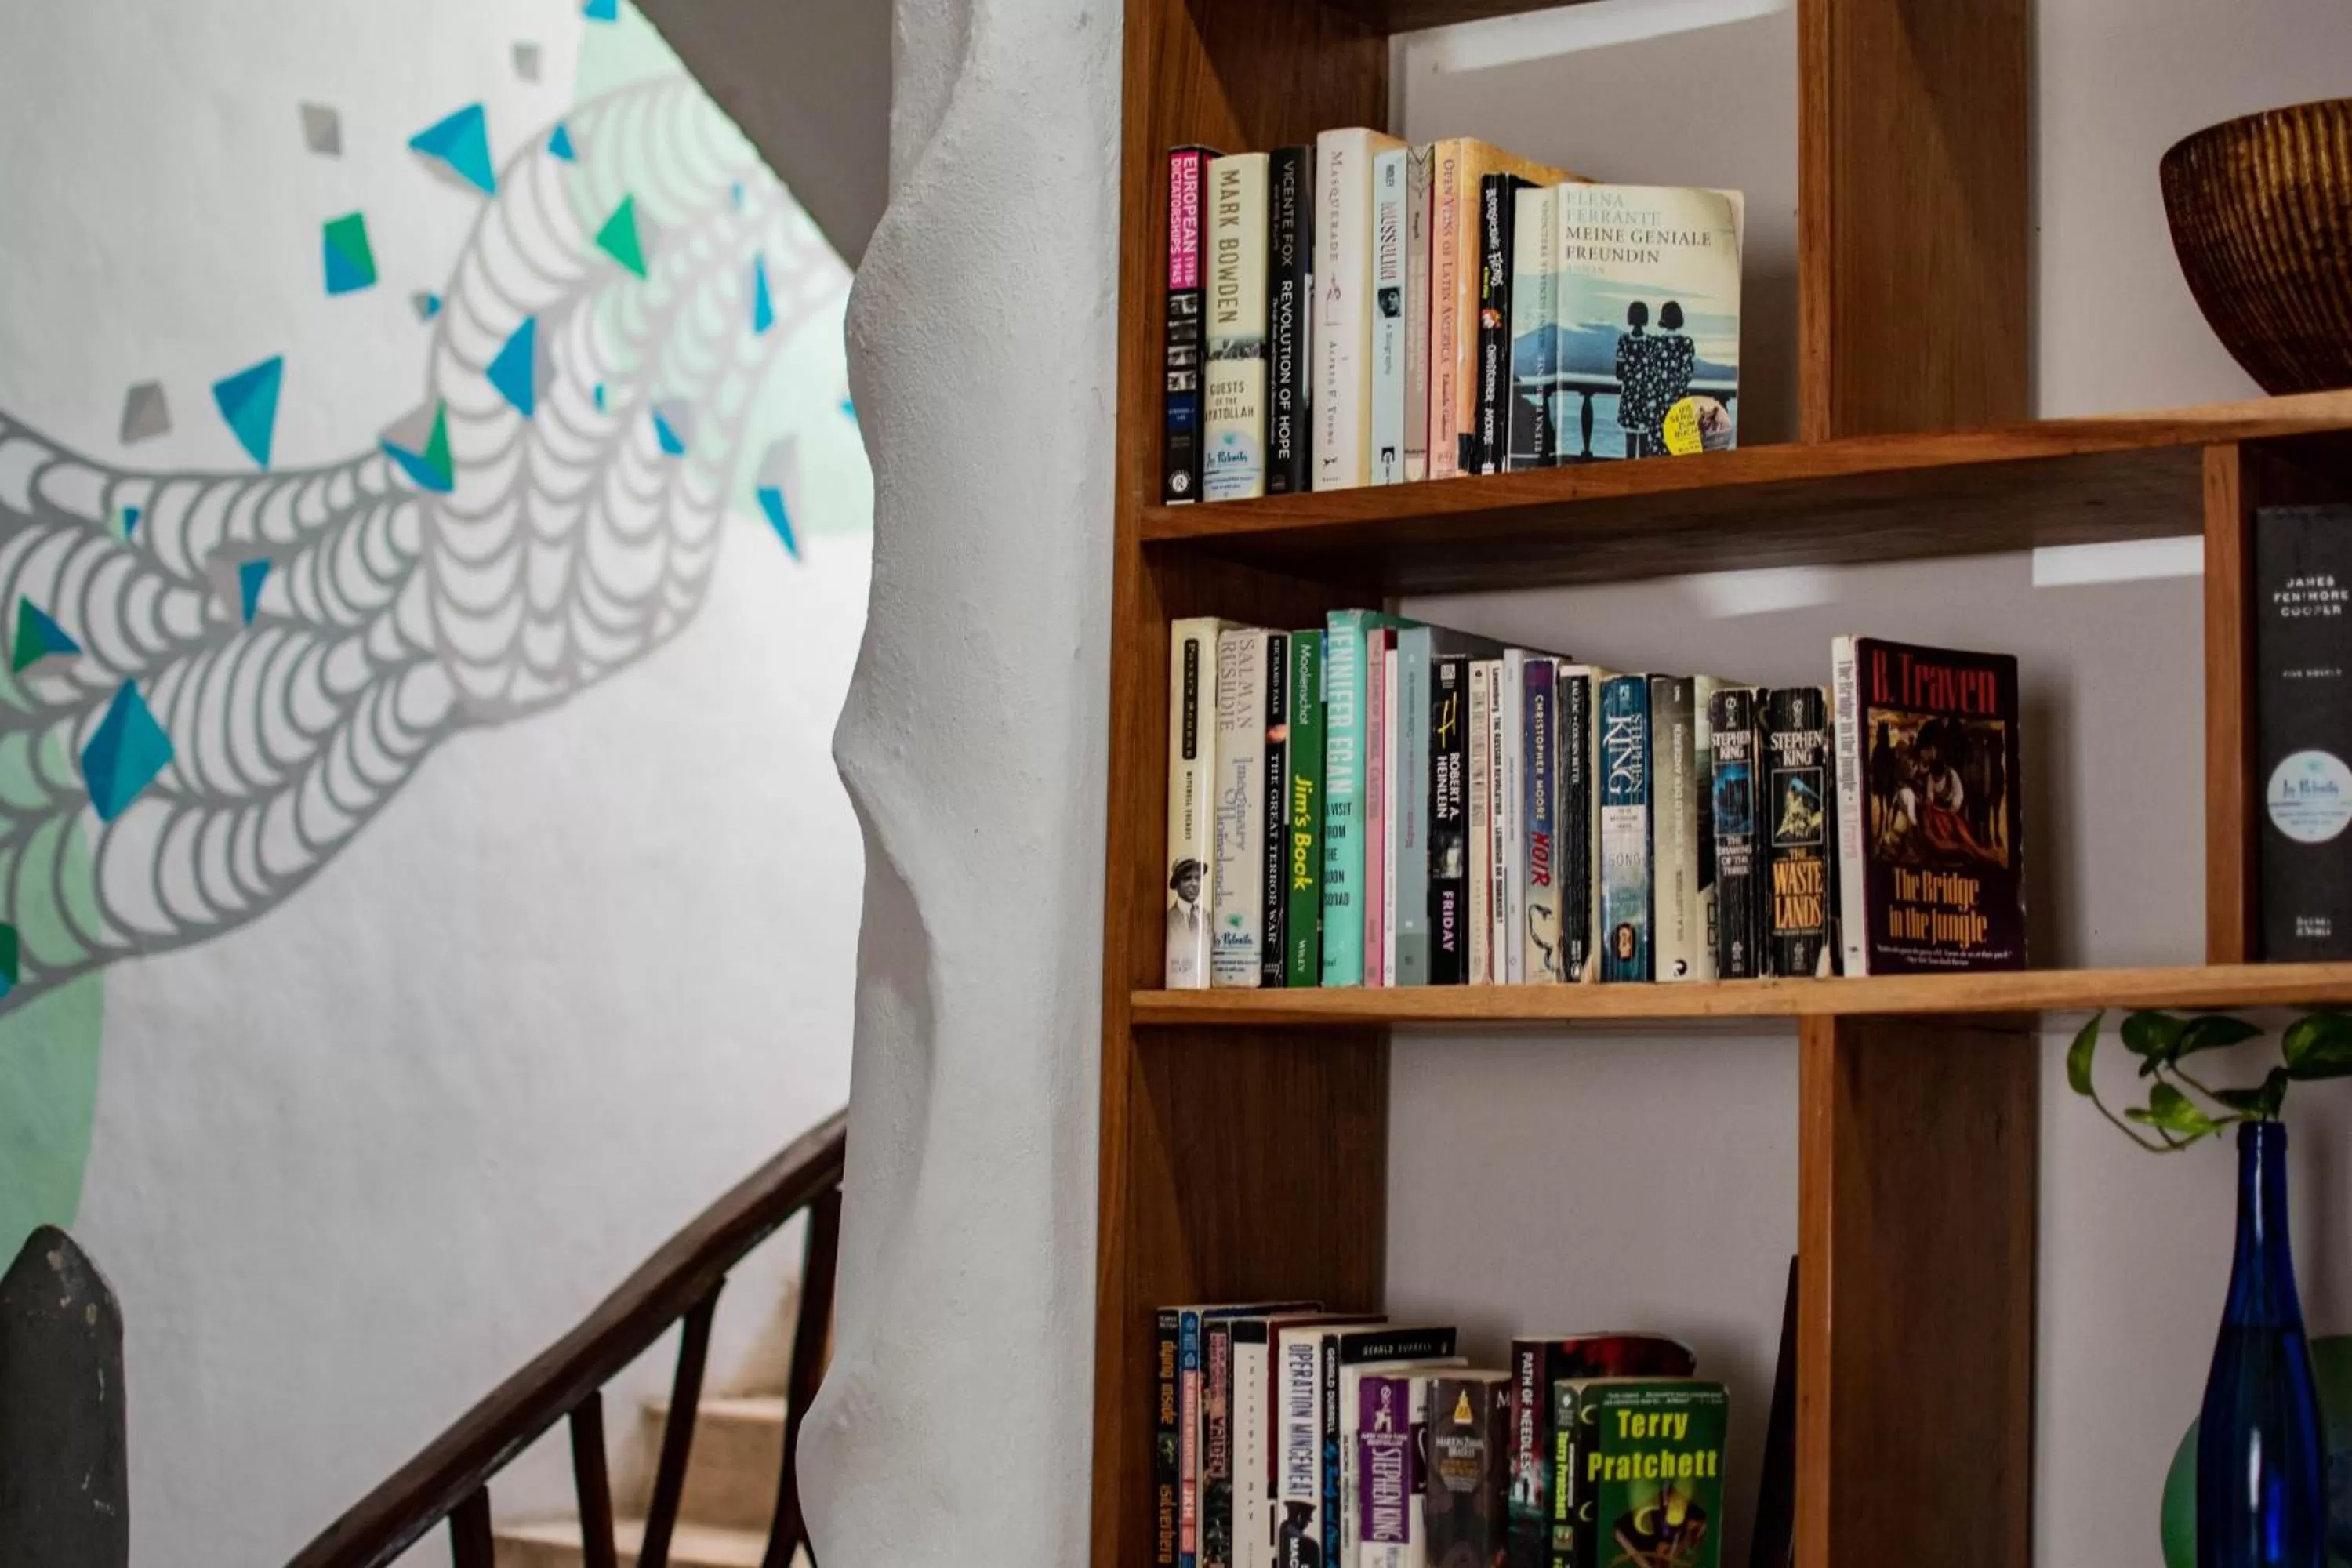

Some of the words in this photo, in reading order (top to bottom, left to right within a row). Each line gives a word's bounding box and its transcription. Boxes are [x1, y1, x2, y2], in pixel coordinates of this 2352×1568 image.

[1282, 160, 1295, 229] VICENTE
[1443, 159, 1456, 195] OPEN
[1171, 158, 1182, 252] DICTATORSHIPS
[1182, 158, 1199, 252] EUROPEAN
[1218, 169, 1240, 228] MARK
[1329, 151, 1343, 262] MASQUERADE
[1566, 191, 1624, 209] ELENA
[1566, 207, 1661, 227] FERRANTE
[1282, 234, 1294, 267] FOX
[1380, 201, 1399, 280] MUSSOLINI
[1565, 225, 1626, 243] MEINE
[1630, 229, 1712, 248] GENIALE
[1566, 245, 1661, 264] FREUNDIN
[1172, 257, 1182, 283] 1945
[1217, 239, 1240, 324] BOWDEN
[1442, 263, 1454, 300] LATIN
[1280, 280, 1293, 383] REVOLUTION
[1441, 305, 1454, 364] AMERICA
[1209, 381, 1244, 395] GUESTS
[1279, 388, 1291, 410] OF
[1279, 416, 1291, 459] HOPE
[1483, 408, 1494, 445] MOORE
[2286, 575, 2335, 588] JAMES
[2280, 604, 2343, 618] COOPER
[1236, 639, 1255, 728] SALMAN
[1272, 639, 1281, 687] RICHARD
[1328, 621, 1355, 728] JENNIFER
[1838, 660, 1854, 679] The
[1896, 652, 1996, 714] Traven
[1219, 641, 1237, 731] RUSHDIE
[1272, 689, 1280, 715] FALK
[1298, 644, 1312, 726] Moolenschot
[1571, 680, 1580, 713] BALZAC
[1837, 681, 1855, 720] Bridge
[1494, 717, 1502, 730] THE
[1534, 695, 1544, 774] CHRISTOPHER
[1712, 731, 1751, 746] STEPHEN
[1770, 730, 1823, 751] STEPHEN
[1840, 721, 1855, 734] in
[1841, 735, 1857, 751] the
[1270, 753, 1280, 786] THE
[1327, 739, 1353, 796] EGAN
[1603, 714, 1632, 794] KING
[1630, 713, 1643, 793] STEPHEN
[1719, 746, 1744, 760] KING
[1783, 746, 1813, 767] KING
[1437, 756, 1449, 818] HEINLEIN
[1450, 753, 1461, 803] ROBERT
[1838, 757, 1857, 792] Jungle
[1225, 757, 1254, 851] Imaginary
[1269, 789, 1279, 839] GREAT
[1294, 774, 1313, 828] Jim's
[1450, 806, 1461, 821] A.
[1535, 779, 1545, 821] MOORE
[1216, 805, 1236, 908] Homelands
[1268, 843, 1279, 905] TERROR
[1293, 833, 1313, 891] Book
[1530, 831, 1552, 887] NOIR
[1773, 861, 1824, 895] WASTE
[1893, 866, 1920, 902] The
[1922, 869, 1979, 913] Bridge
[1267, 908, 1278, 943] WAR
[1443, 891, 1454, 951] FRIDAY
[1774, 895, 1822, 928] LANDS
[1889, 903, 1904, 938] in
[1905, 907, 1929, 940] the
[1931, 908, 1987, 949] Jungle
[1158, 1340, 1178, 1378] dying
[1327, 1348, 1336, 1387] GERALD
[1521, 1352, 1534, 1386] PATH
[1287, 1344, 1314, 1417] OPERATION
[1521, 1388, 1534, 1406] OF
[1160, 1382, 1178, 1425] inside
[1327, 1391, 1336, 1434] DURRELL
[1617, 1409, 1689, 1440] Terry
[1519, 1408, 1533, 1470] NEEDLES
[1287, 1423, 1314, 1498] MINCEMEAT
[1371, 1447, 1403, 1505] STEPHEN
[1587, 1450, 1718, 1482] Pratchett
[1372, 1508, 1403, 1541] KING
